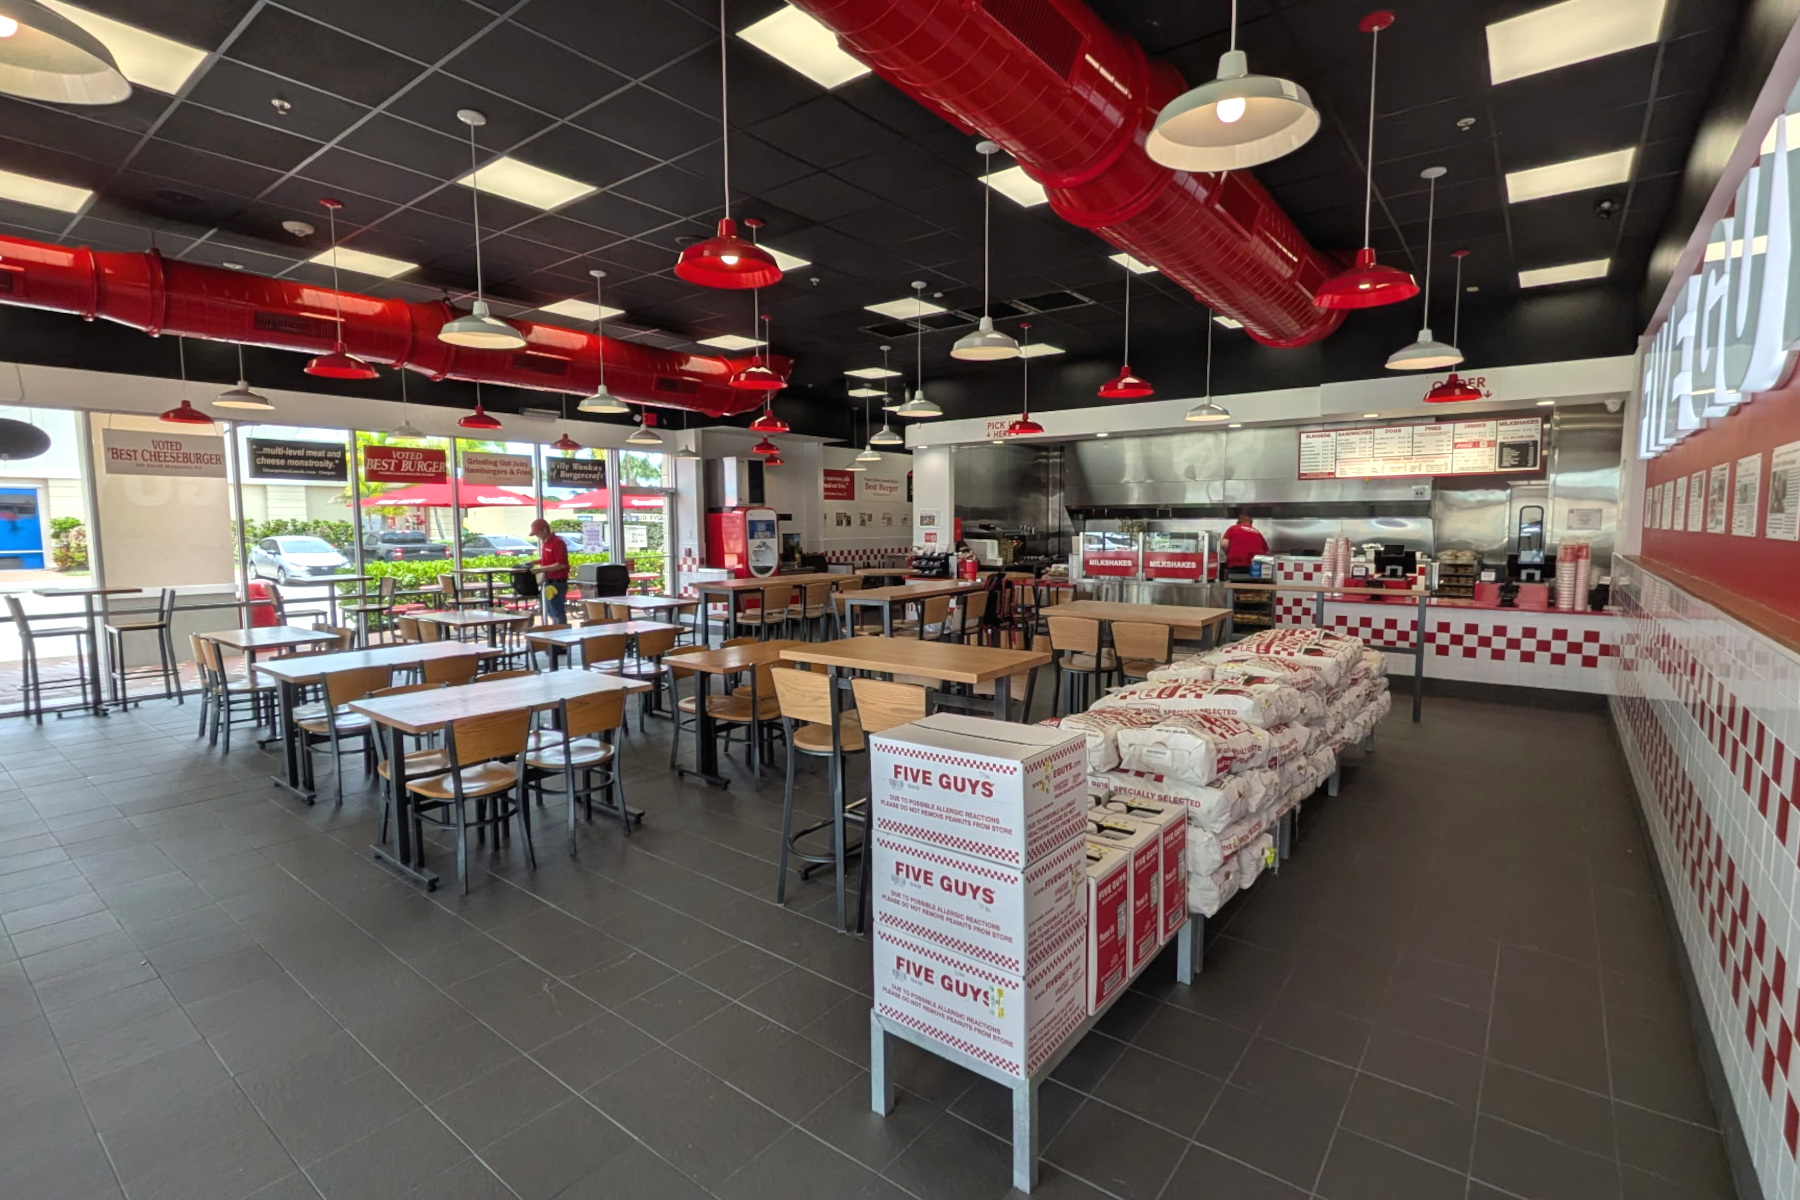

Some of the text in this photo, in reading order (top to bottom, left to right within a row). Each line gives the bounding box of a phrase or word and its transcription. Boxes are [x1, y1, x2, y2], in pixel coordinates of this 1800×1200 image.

[988, 421, 1006, 430] PICK
[152, 440, 182, 452] VOTED
[327, 450, 342, 458] and
[392, 451, 423, 460] VOTED
[256, 456, 285, 466] cheese
[366, 458, 446, 473] BEST BURGER
[465, 466, 508, 476] Hamburgers
[510, 468, 515, 476] &
[467, 458, 498, 466] Grinding
[549, 470, 558, 480] of
[865, 482, 900, 492] Best Burger
[1089, 559, 1132, 567] MILKSHAKES
[1149, 560, 1196, 568] MILKSHAKES
[894, 764, 932, 786] FIVE
[938, 774, 994, 798] GUYS
[1114, 785, 1156, 800] SPECIALLY
[1158, 794, 1201, 808] SELECTED
[881, 800, 899, 809] PLEASE
[909, 806, 920, 814] NOT
[921, 808, 943, 819] REMOVE
[945, 814, 971, 826] PEANUTS
[973, 820, 990, 830] FROM
[992, 825, 1013, 835] STORE
[909, 798, 935, 809] POSSIBLE
[937, 803, 963, 816] ALLERGIC
[965, 812, 999, 824] REACTIONS
[1164, 831, 1173, 845] FIVE
[1174, 823, 1184, 838] GUYS
[1135, 853, 1145, 871] FIVE
[1146, 844, 1157, 861] GUYS
[895, 861, 934, 887] FIVE
[940, 875, 995, 904] GUYS
[1098, 882, 1111, 901] FIVE
[1112, 871, 1126, 890] GUYS
[882, 894, 1013, 944] PLEASE DO NOT REMOVE PEANUTS FROM STORE
[891, 890, 902, 898] DUE
[911, 896, 936, 910] POSSIBLE
[937, 904, 964, 920] ALLERGIC
[966, 914, 1000, 931] REACTIONS
[896, 955, 934, 985] FIVE
[882, 986, 1014, 1048] PLEASE DO NOT REMOVE PEANUTS FROM STORE
[892, 984, 1001, 1035] DUE TO POSSIBLE ALLERGIC REACTIONS
